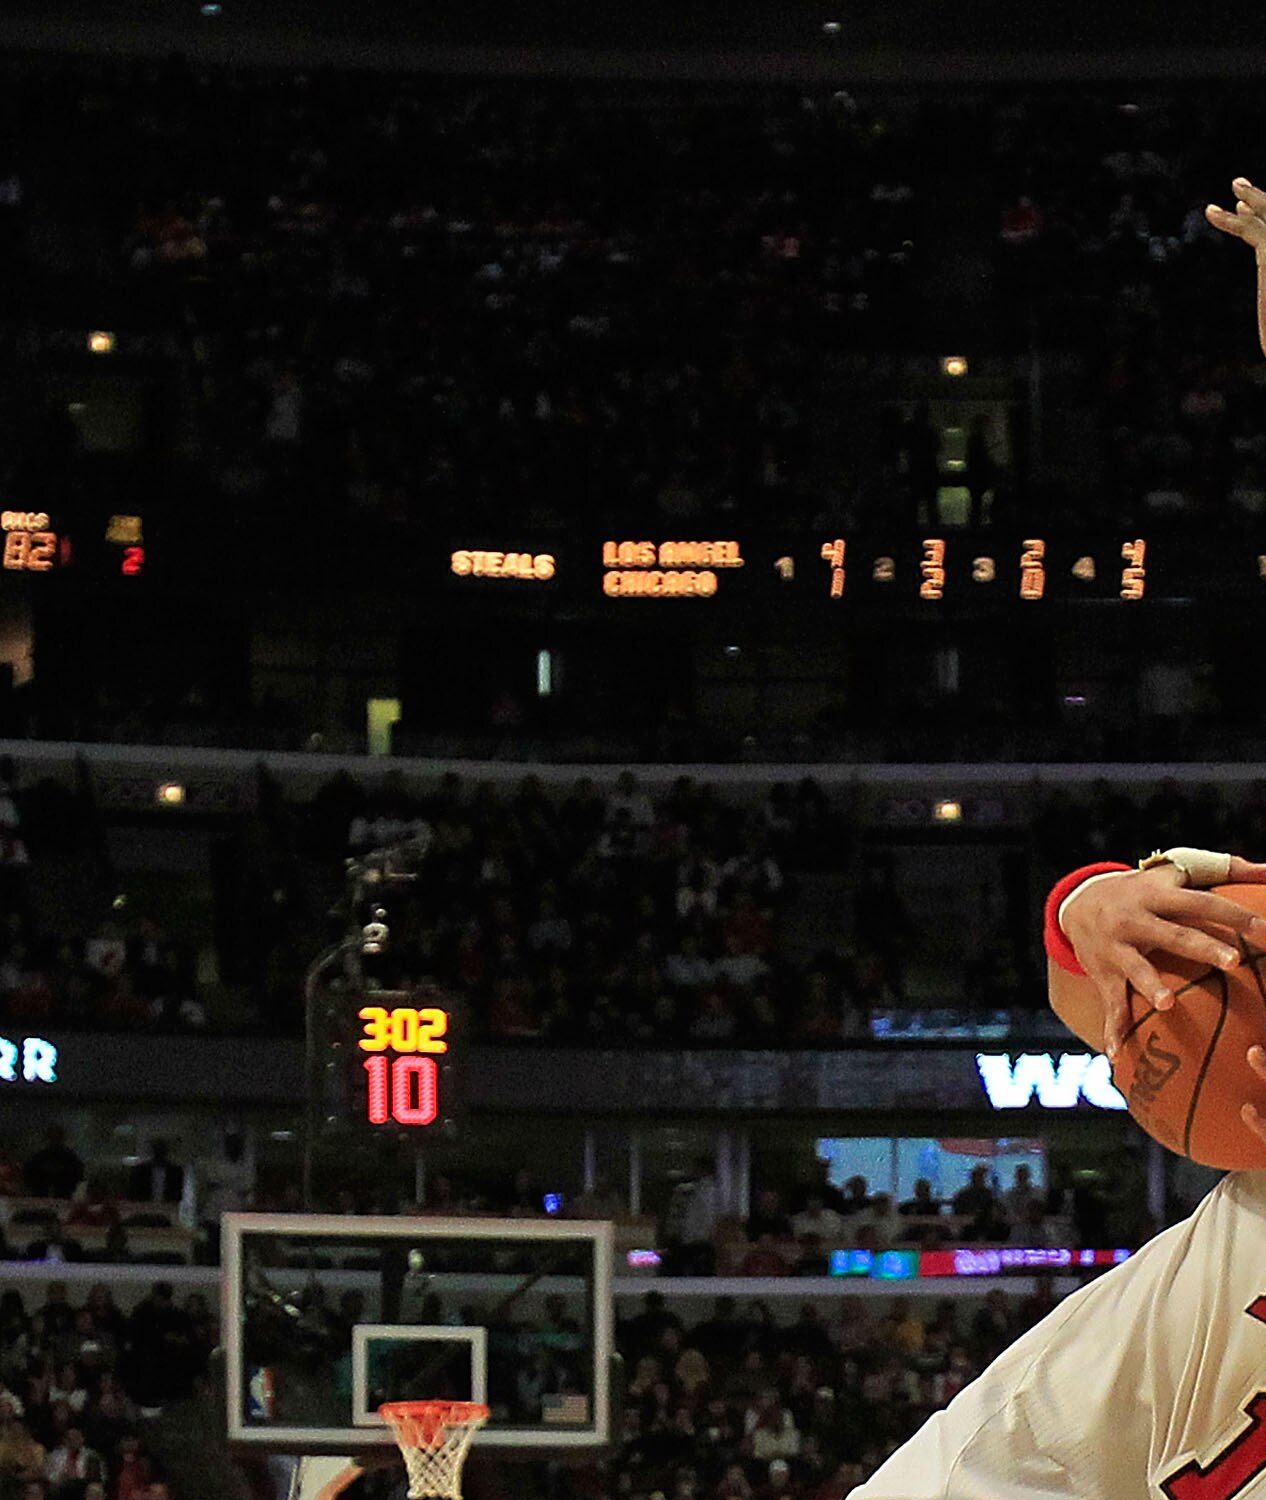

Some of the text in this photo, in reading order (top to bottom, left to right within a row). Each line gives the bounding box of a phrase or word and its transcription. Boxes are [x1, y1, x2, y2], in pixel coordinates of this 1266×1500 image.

[451, 550, 556, 580] STEALS
[603, 541, 657, 568] LOS
[603, 571, 718, 598] CHICAGO
[363, 1055, 438, 1126] 10
